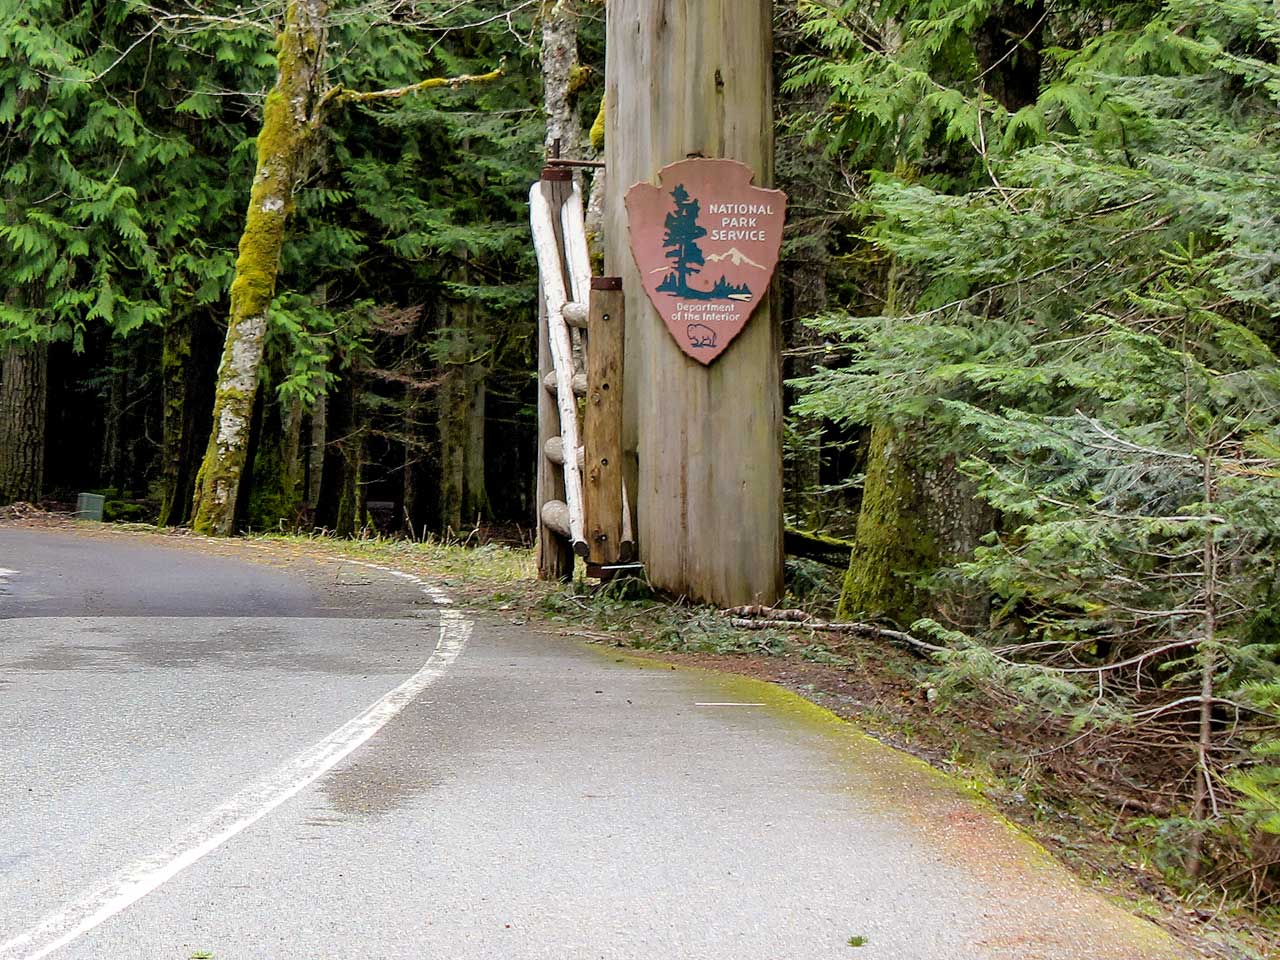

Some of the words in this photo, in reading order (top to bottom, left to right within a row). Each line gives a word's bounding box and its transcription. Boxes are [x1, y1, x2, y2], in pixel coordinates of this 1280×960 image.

[709, 204, 774, 215] NATIONAL
[721, 218, 757, 228] PARK
[710, 230, 766, 241] SERVICE
[676, 303, 735, 313] Department
[671, 312, 681, 321] of
[684, 312, 701, 321] the
[702, 313, 740, 321] Interior
